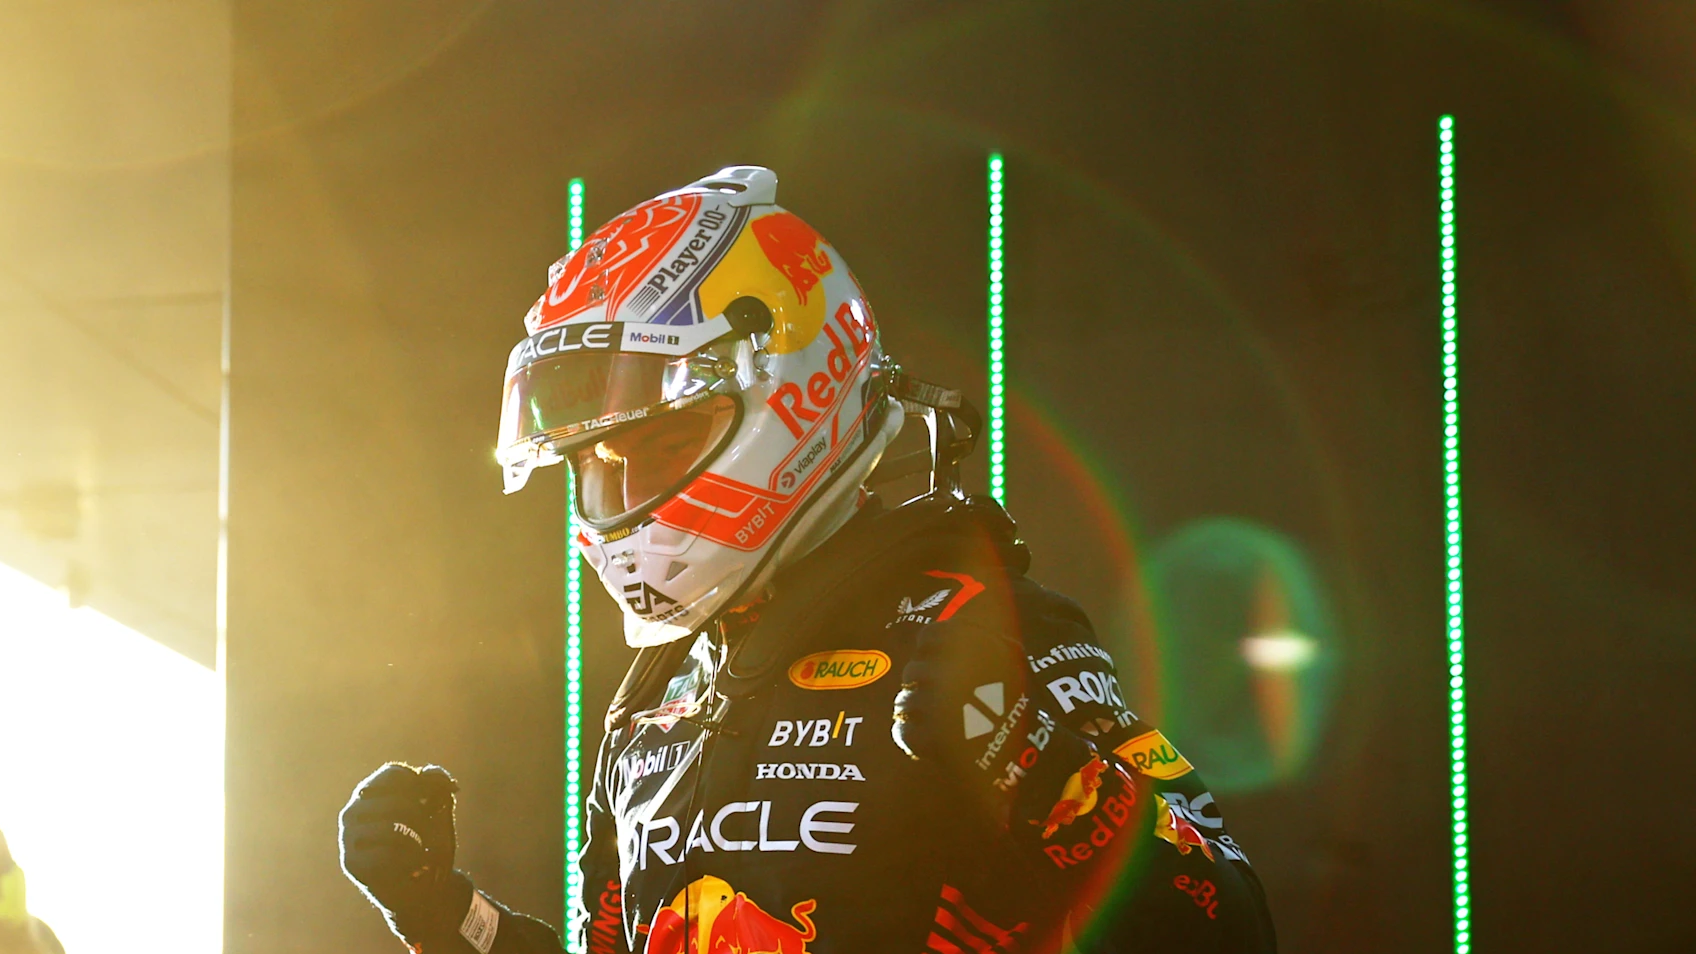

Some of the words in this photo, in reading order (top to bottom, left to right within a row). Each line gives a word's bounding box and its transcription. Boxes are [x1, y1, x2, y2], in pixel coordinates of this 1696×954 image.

[517, 324, 613, 366] ACLE
[630, 332, 666, 344] Mobil
[794, 436, 828, 474] viaplay
[734, 501, 776, 544] BYBIT
[884, 613, 933, 629] CSTORE
[814, 658, 879, 679] RAUCH
[1046, 671, 1127, 715] ROK
[768, 710, 864, 747] BYBIT
[975, 692, 1030, 771] inter.mx
[755, 762, 867, 782] HONDA
[1131, 744, 1179, 771] RAU
